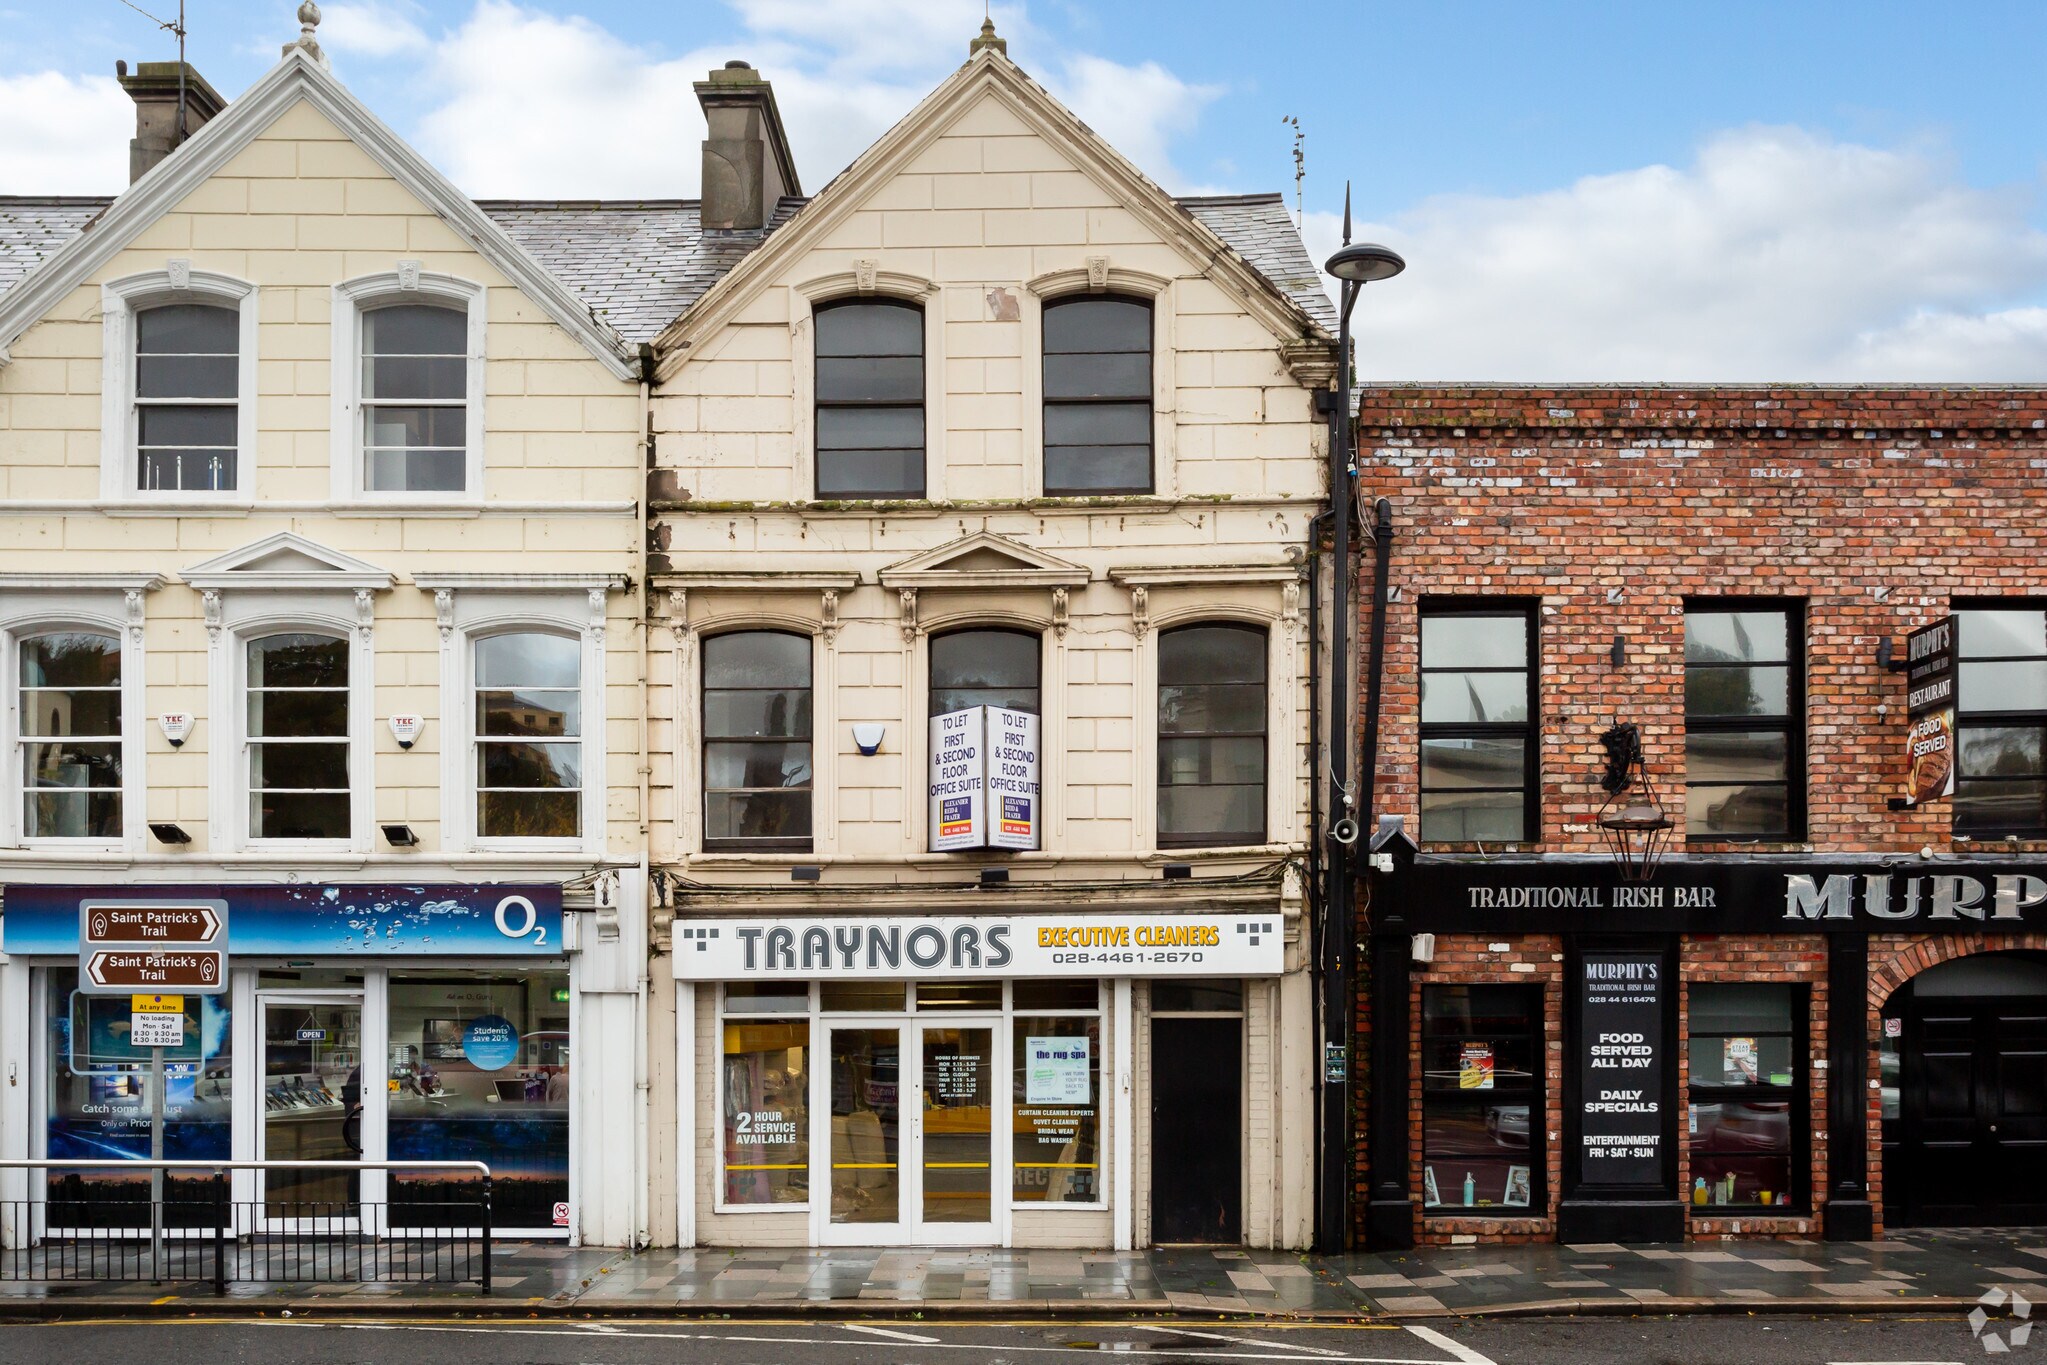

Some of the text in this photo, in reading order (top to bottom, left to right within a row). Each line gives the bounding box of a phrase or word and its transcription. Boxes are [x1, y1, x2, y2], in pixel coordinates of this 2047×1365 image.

[1910, 623, 1950, 661] MURPHY'S
[1910, 679, 1951, 708] RESTAURANT
[943, 714, 968, 730] TO LET
[1002, 713, 1027, 728] TO LET
[1918, 718, 1941, 737] FOOD
[944, 733, 965, 748] FIRST
[1005, 732, 1025, 746] FIRST
[1914, 735, 1946, 758] SERVED
[936, 747, 975, 765] & SECOND
[995, 746, 1034, 763] & SECOND
[942, 764, 968, 779] FLOOR
[1002, 763, 1027, 777] FLOOR
[930, 778, 981, 796] OFFICE SUITE
[990, 777, 1039, 794] OFFICE SUITE
[944, 799, 968, 807] ALEXANDER
[1005, 798, 1028, 806] ALEXANDER
[1468, 887, 1716, 908] TRADITIONAL IRISH BAR
[111, 912, 198, 923] Saint Patrick's
[141, 926, 168, 936] Trail
[1037, 926, 1220, 948] EXECUTIVE CLEANERS
[736, 924, 1012, 970] TRAYNORS
[110, 956, 196, 967] Saint Patrick's
[1053, 952, 1203, 963] 028-4461-2670
[140, 970, 166, 980] Trail
[1586, 964, 1658, 979] MURPHY'S
[1600, 1033, 1644, 1043] FOOD
[1036, 1051, 1050, 1059] the
[1591, 1046, 1653, 1055] SERVED
[1591, 1058, 1652, 1067] ALL DAY
[1601, 1090, 1642, 1100] DAILY
[82, 1104, 109, 1114] Catch
[112, 1106, 138, 1114] some
[1585, 1102, 1658, 1112] SPECIALS
[736, 1112, 782, 1133] 2 HOUR
[754, 1123, 796, 1133] SERVICE
[736, 1134, 796, 1144] AVAILABLE
[1583, 1136, 1660, 1145] ENTERTAINMENT
[1589, 1148, 1654, 1157] FRI SAT SUN
